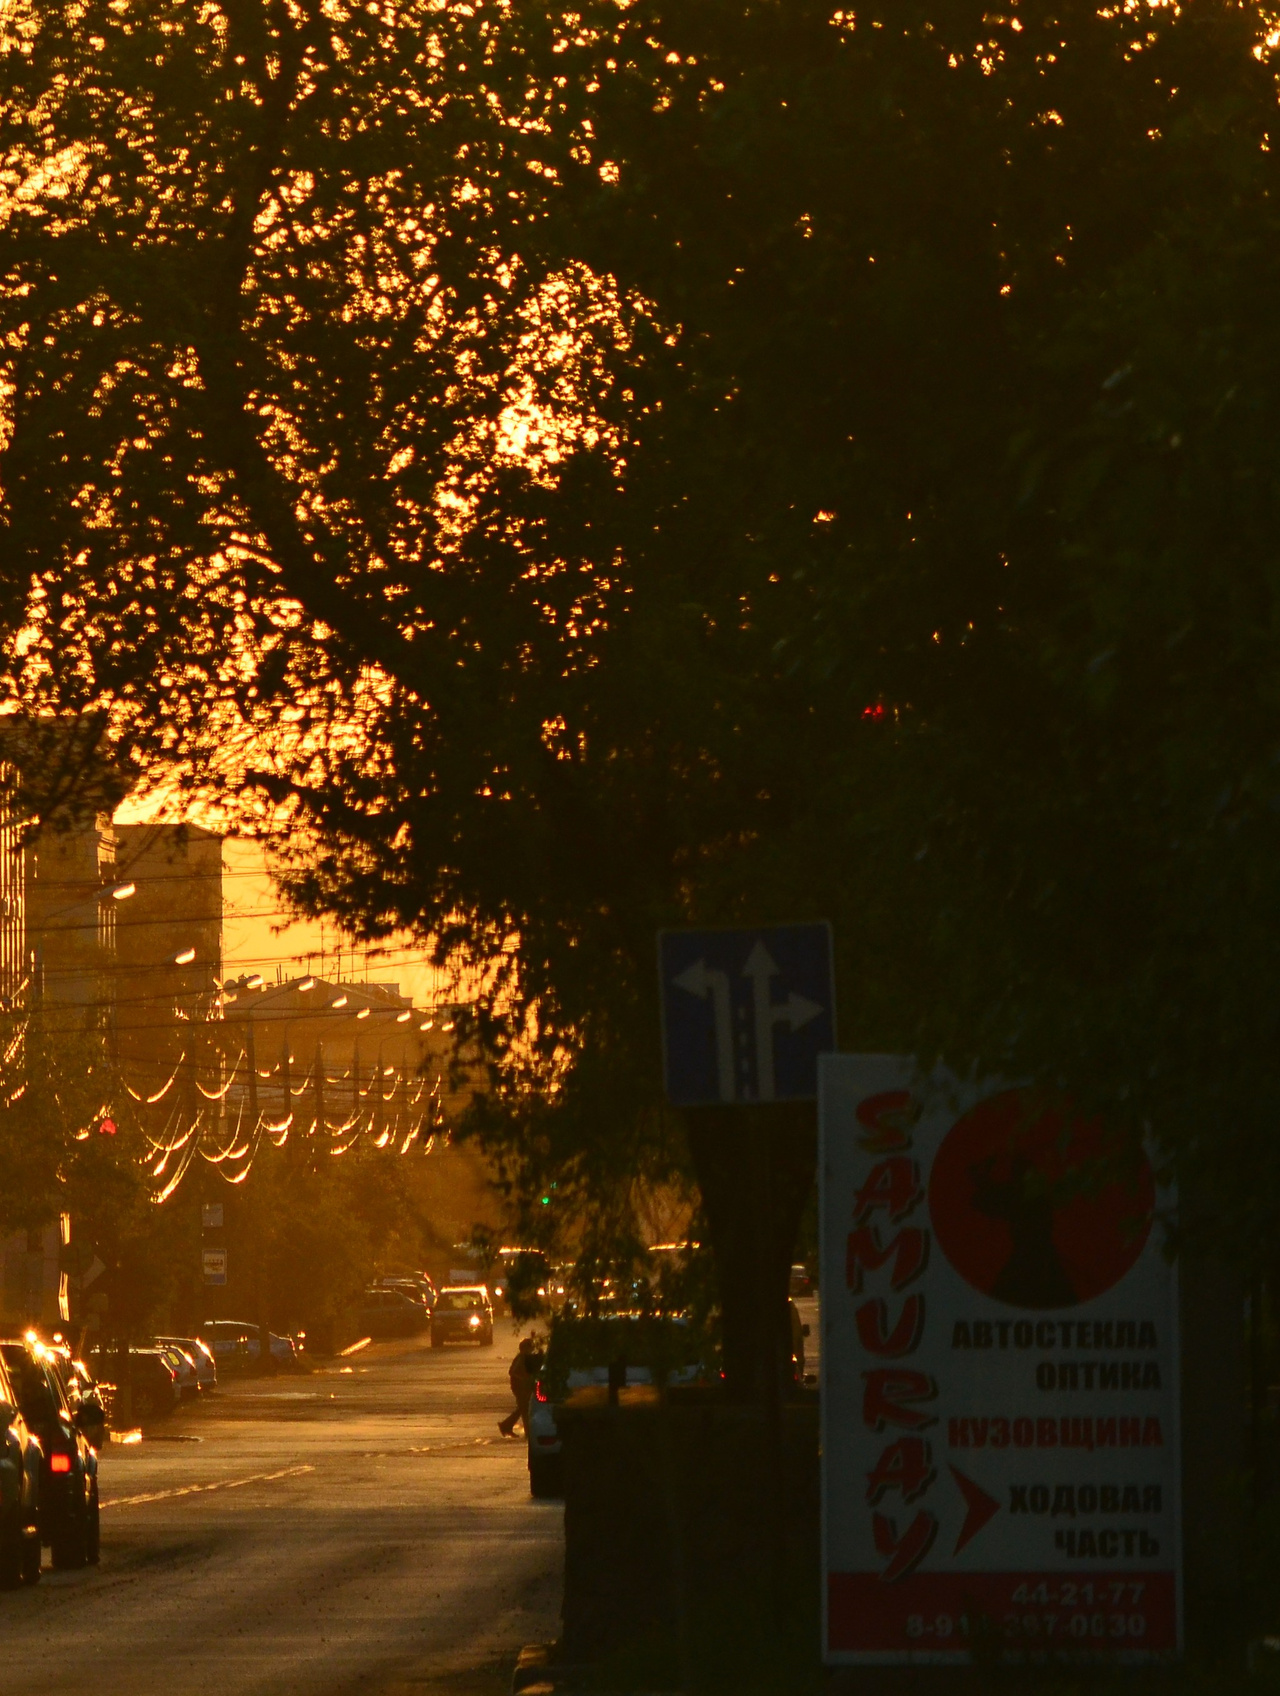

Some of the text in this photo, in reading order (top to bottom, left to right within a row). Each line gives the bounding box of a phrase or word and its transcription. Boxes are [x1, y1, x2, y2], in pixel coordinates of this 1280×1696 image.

[845, 1089, 939, 1583] SAMURAY
[952, 1320, 1158, 1349] АВТОСТЕКЛА
[1035, 1361, 1162, 1391] ОПТИКА
[947, 1417, 1163, 1449] КУЗОВЩИНА
[1008, 1484, 1162, 1516] ХОДОВАЯ
[1055, 1529, 1160, 1559] ЧАСТЬ
[1010, 1581, 1146, 1606] 44-21-77
